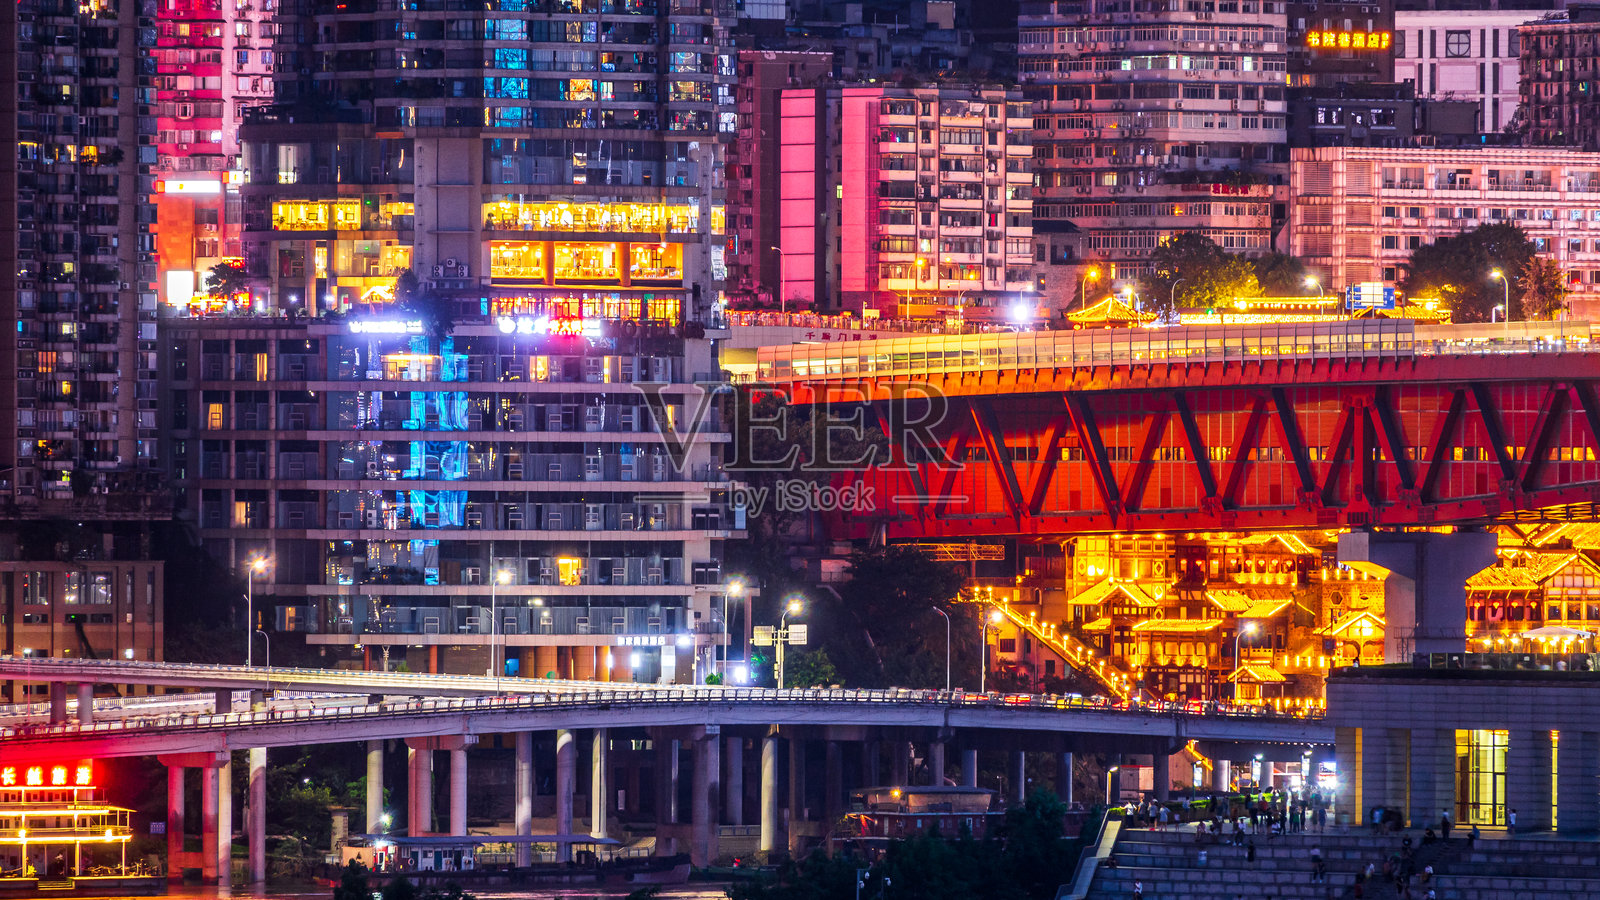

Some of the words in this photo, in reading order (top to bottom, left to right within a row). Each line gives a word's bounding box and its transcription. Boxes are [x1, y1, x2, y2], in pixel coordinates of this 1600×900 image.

[1307, 31, 1379, 47] 书院巷酒店
